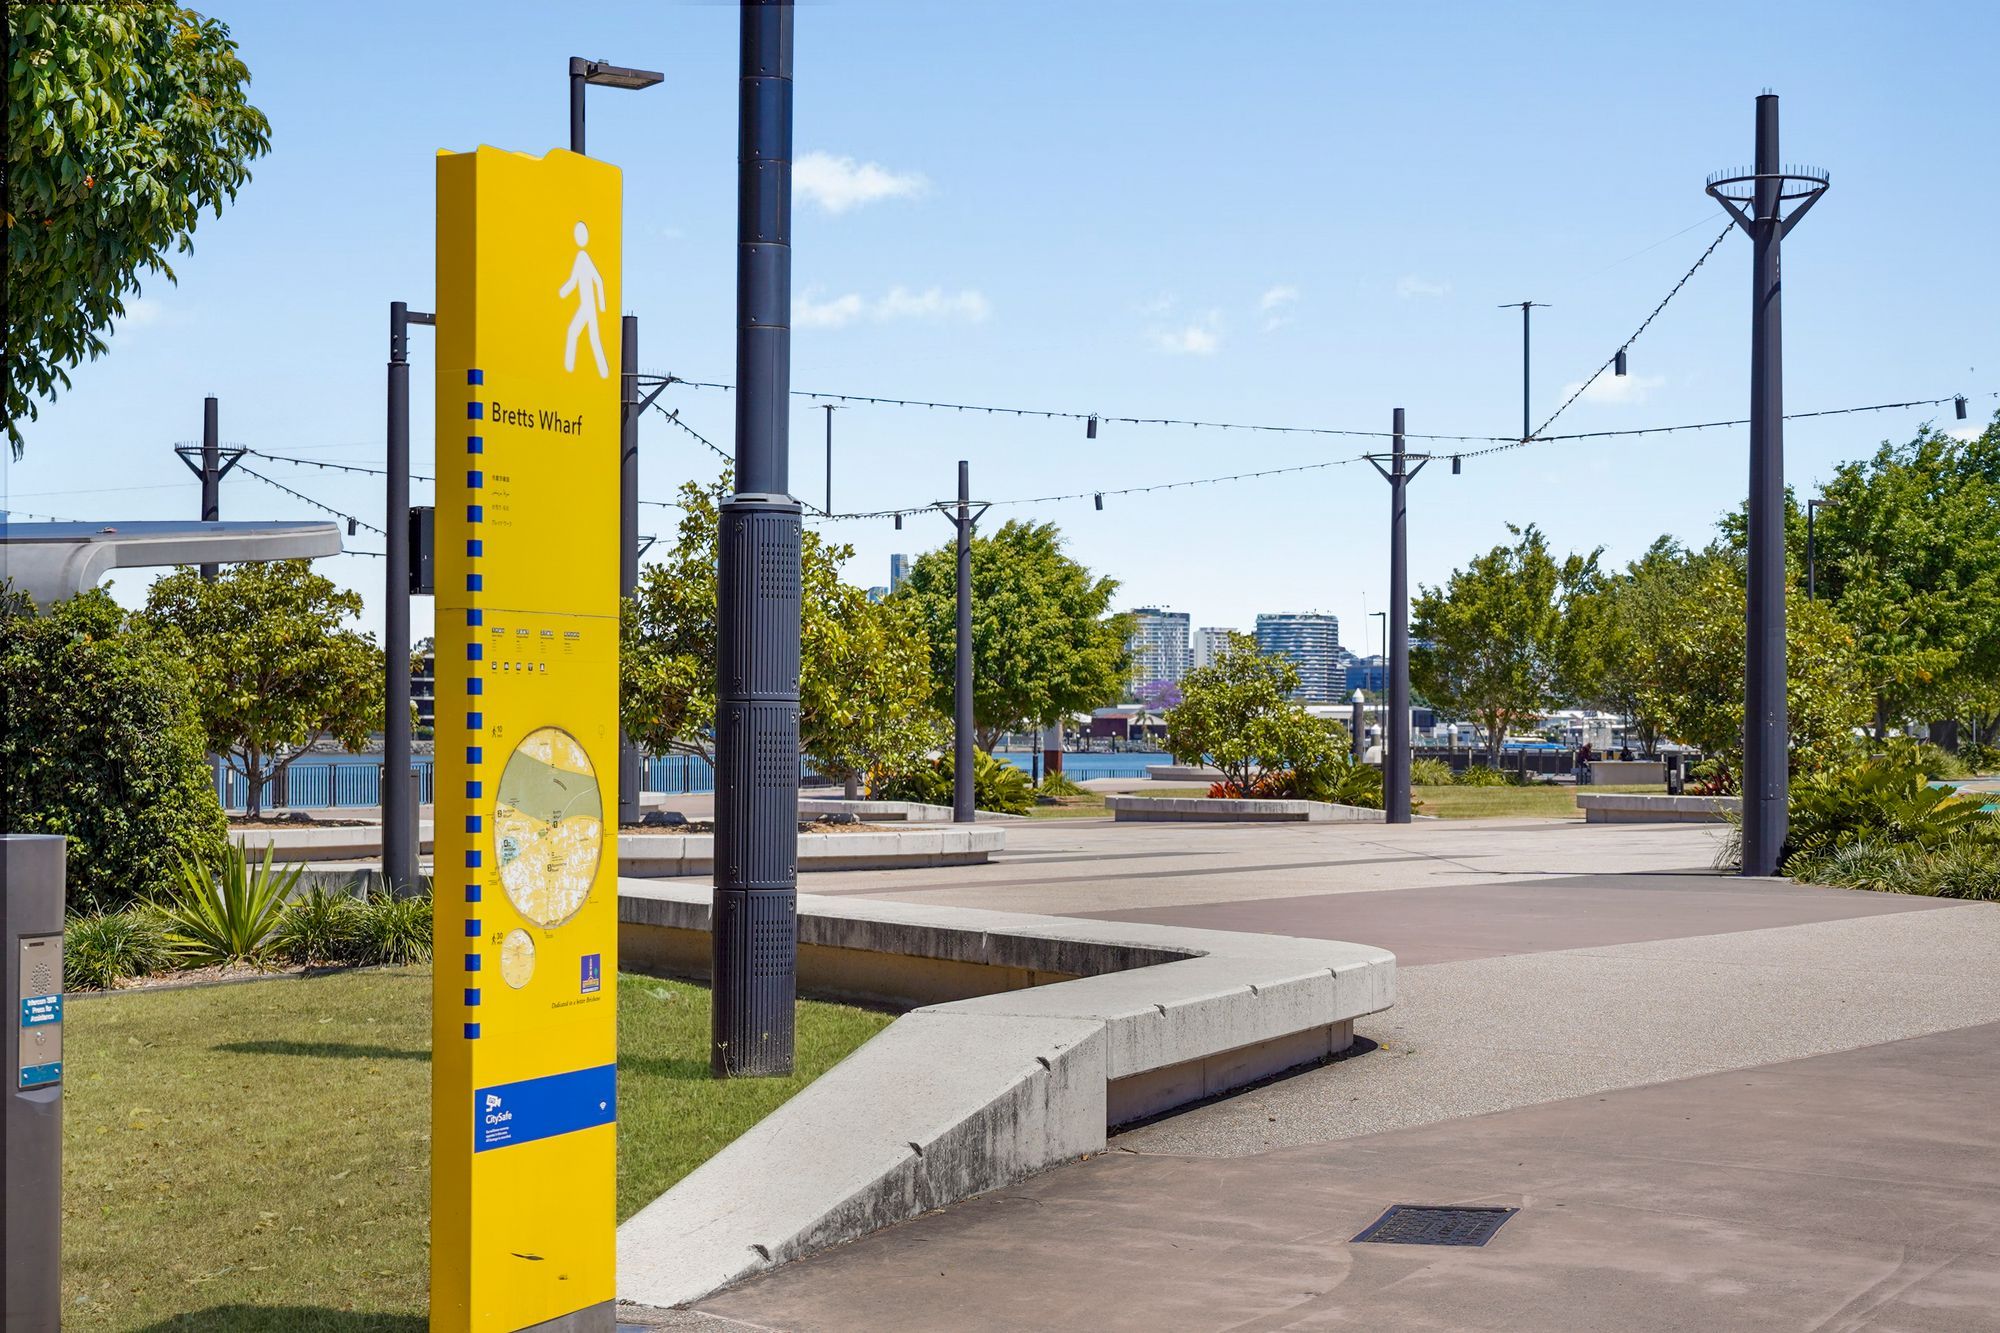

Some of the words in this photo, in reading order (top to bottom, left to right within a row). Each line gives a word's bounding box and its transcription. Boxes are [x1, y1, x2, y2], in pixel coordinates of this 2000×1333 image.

[492, 402, 535, 428] Bretts
[539, 409, 583, 436] Wharf
[486, 1111, 512, 1125] CitySafe
